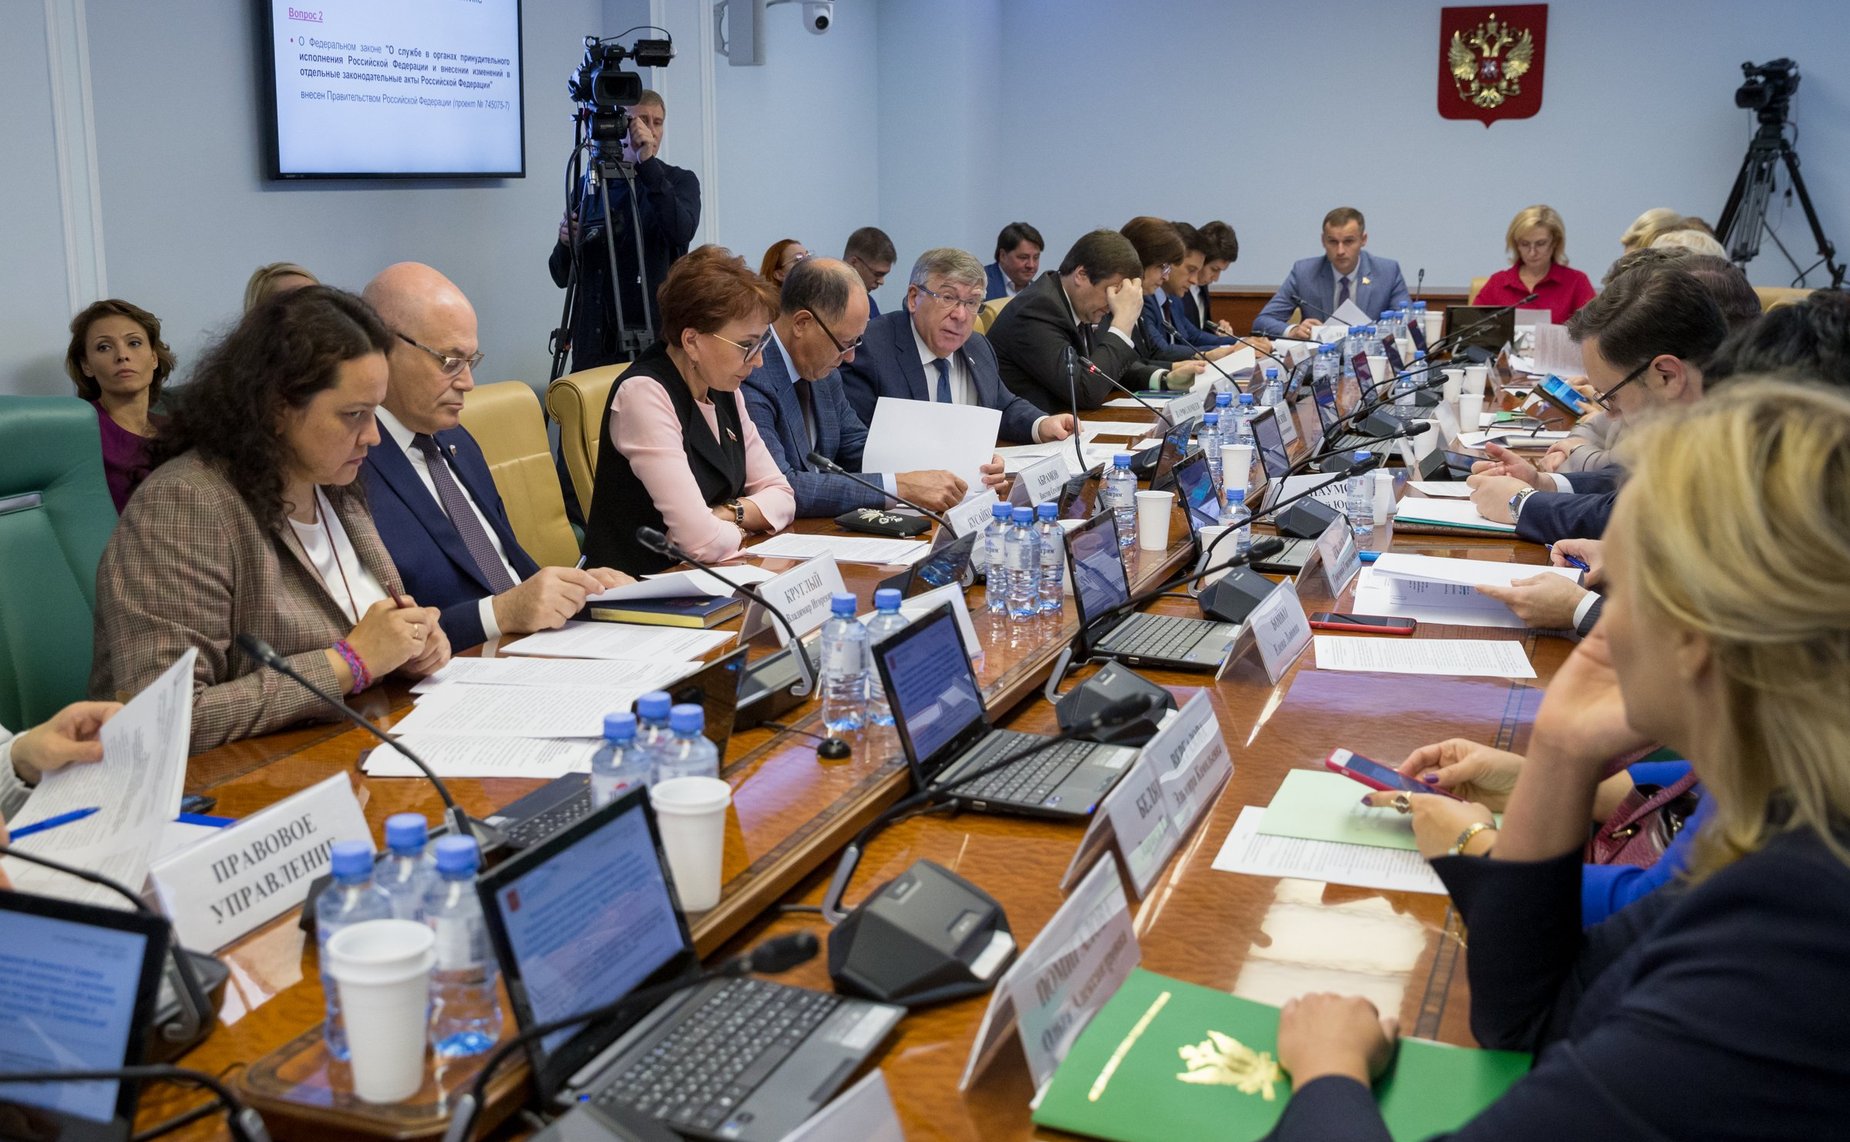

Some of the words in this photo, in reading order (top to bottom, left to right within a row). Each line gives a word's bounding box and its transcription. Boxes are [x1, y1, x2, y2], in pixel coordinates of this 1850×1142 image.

[288, 7, 317, 21] Вопрос
[318, 11, 323, 21] 2
[298, 36, 305, 46] О
[309, 38, 356, 51] Федеральном
[360, 44, 382, 54] законе
[398, 48, 422, 58] службе
[433, 51, 457, 61] органах
[460, 54, 510, 66] принудительного
[299, 53, 343, 64] исполнения
[348, 55, 388, 68] Российской
[392, 60, 428, 72] Федерации
[441, 65, 469, 75] внесении
[472, 69, 503, 78] изменений
[300, 68, 340, 79] отдельные
[342, 71, 402, 83] законодательные
[404, 76, 420, 84] акты
[421, 75, 457, 86] Российской
[458, 79, 493, 90] Федерации"
[300, 91, 325, 100] внесен
[327, 90, 381, 103] Правительством
[382, 94, 418, 105] Российской
[420, 97, 452, 107] Федерации
[453, 98, 476, 109] (проект
[784, 571, 823, 604] КРУГЛЫЙ
[210, 813, 318, 884] ПРАВОВОЕ
